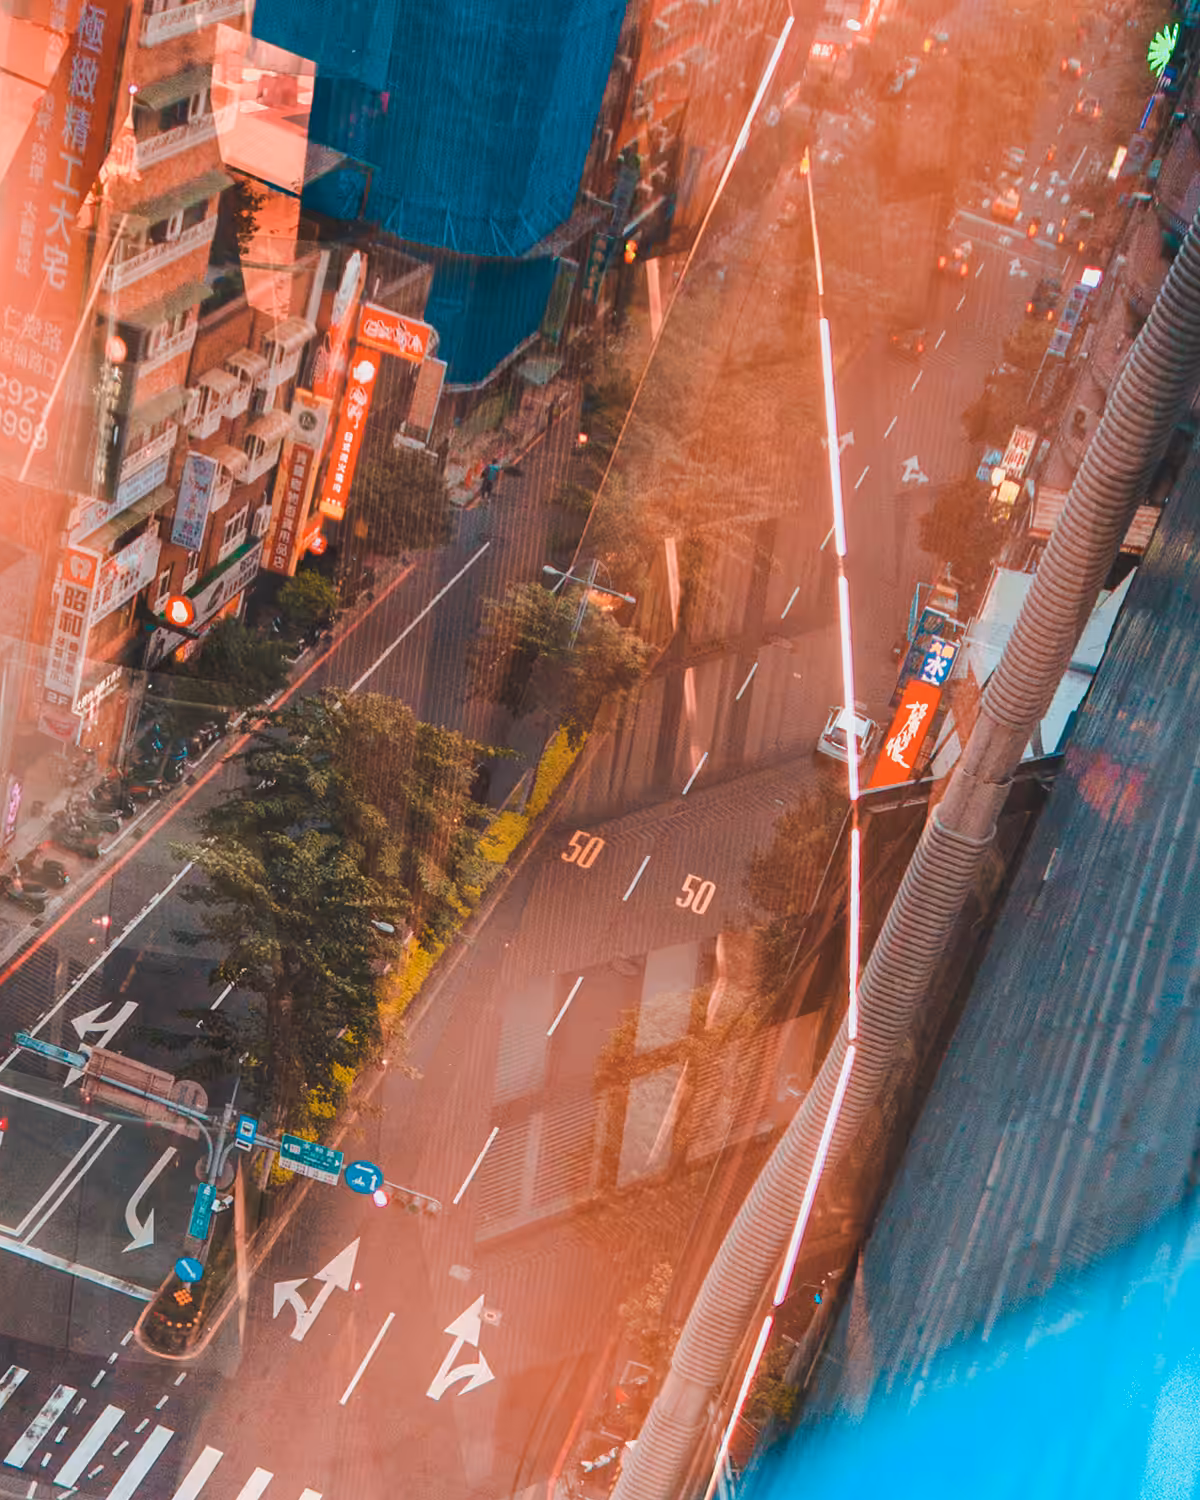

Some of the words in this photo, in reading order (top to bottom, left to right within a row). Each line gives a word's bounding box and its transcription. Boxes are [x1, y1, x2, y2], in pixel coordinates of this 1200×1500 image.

[58, 584, 88, 637] 昭和
[560, 829, 605, 869] 50
[675, 873, 717, 915] 50
